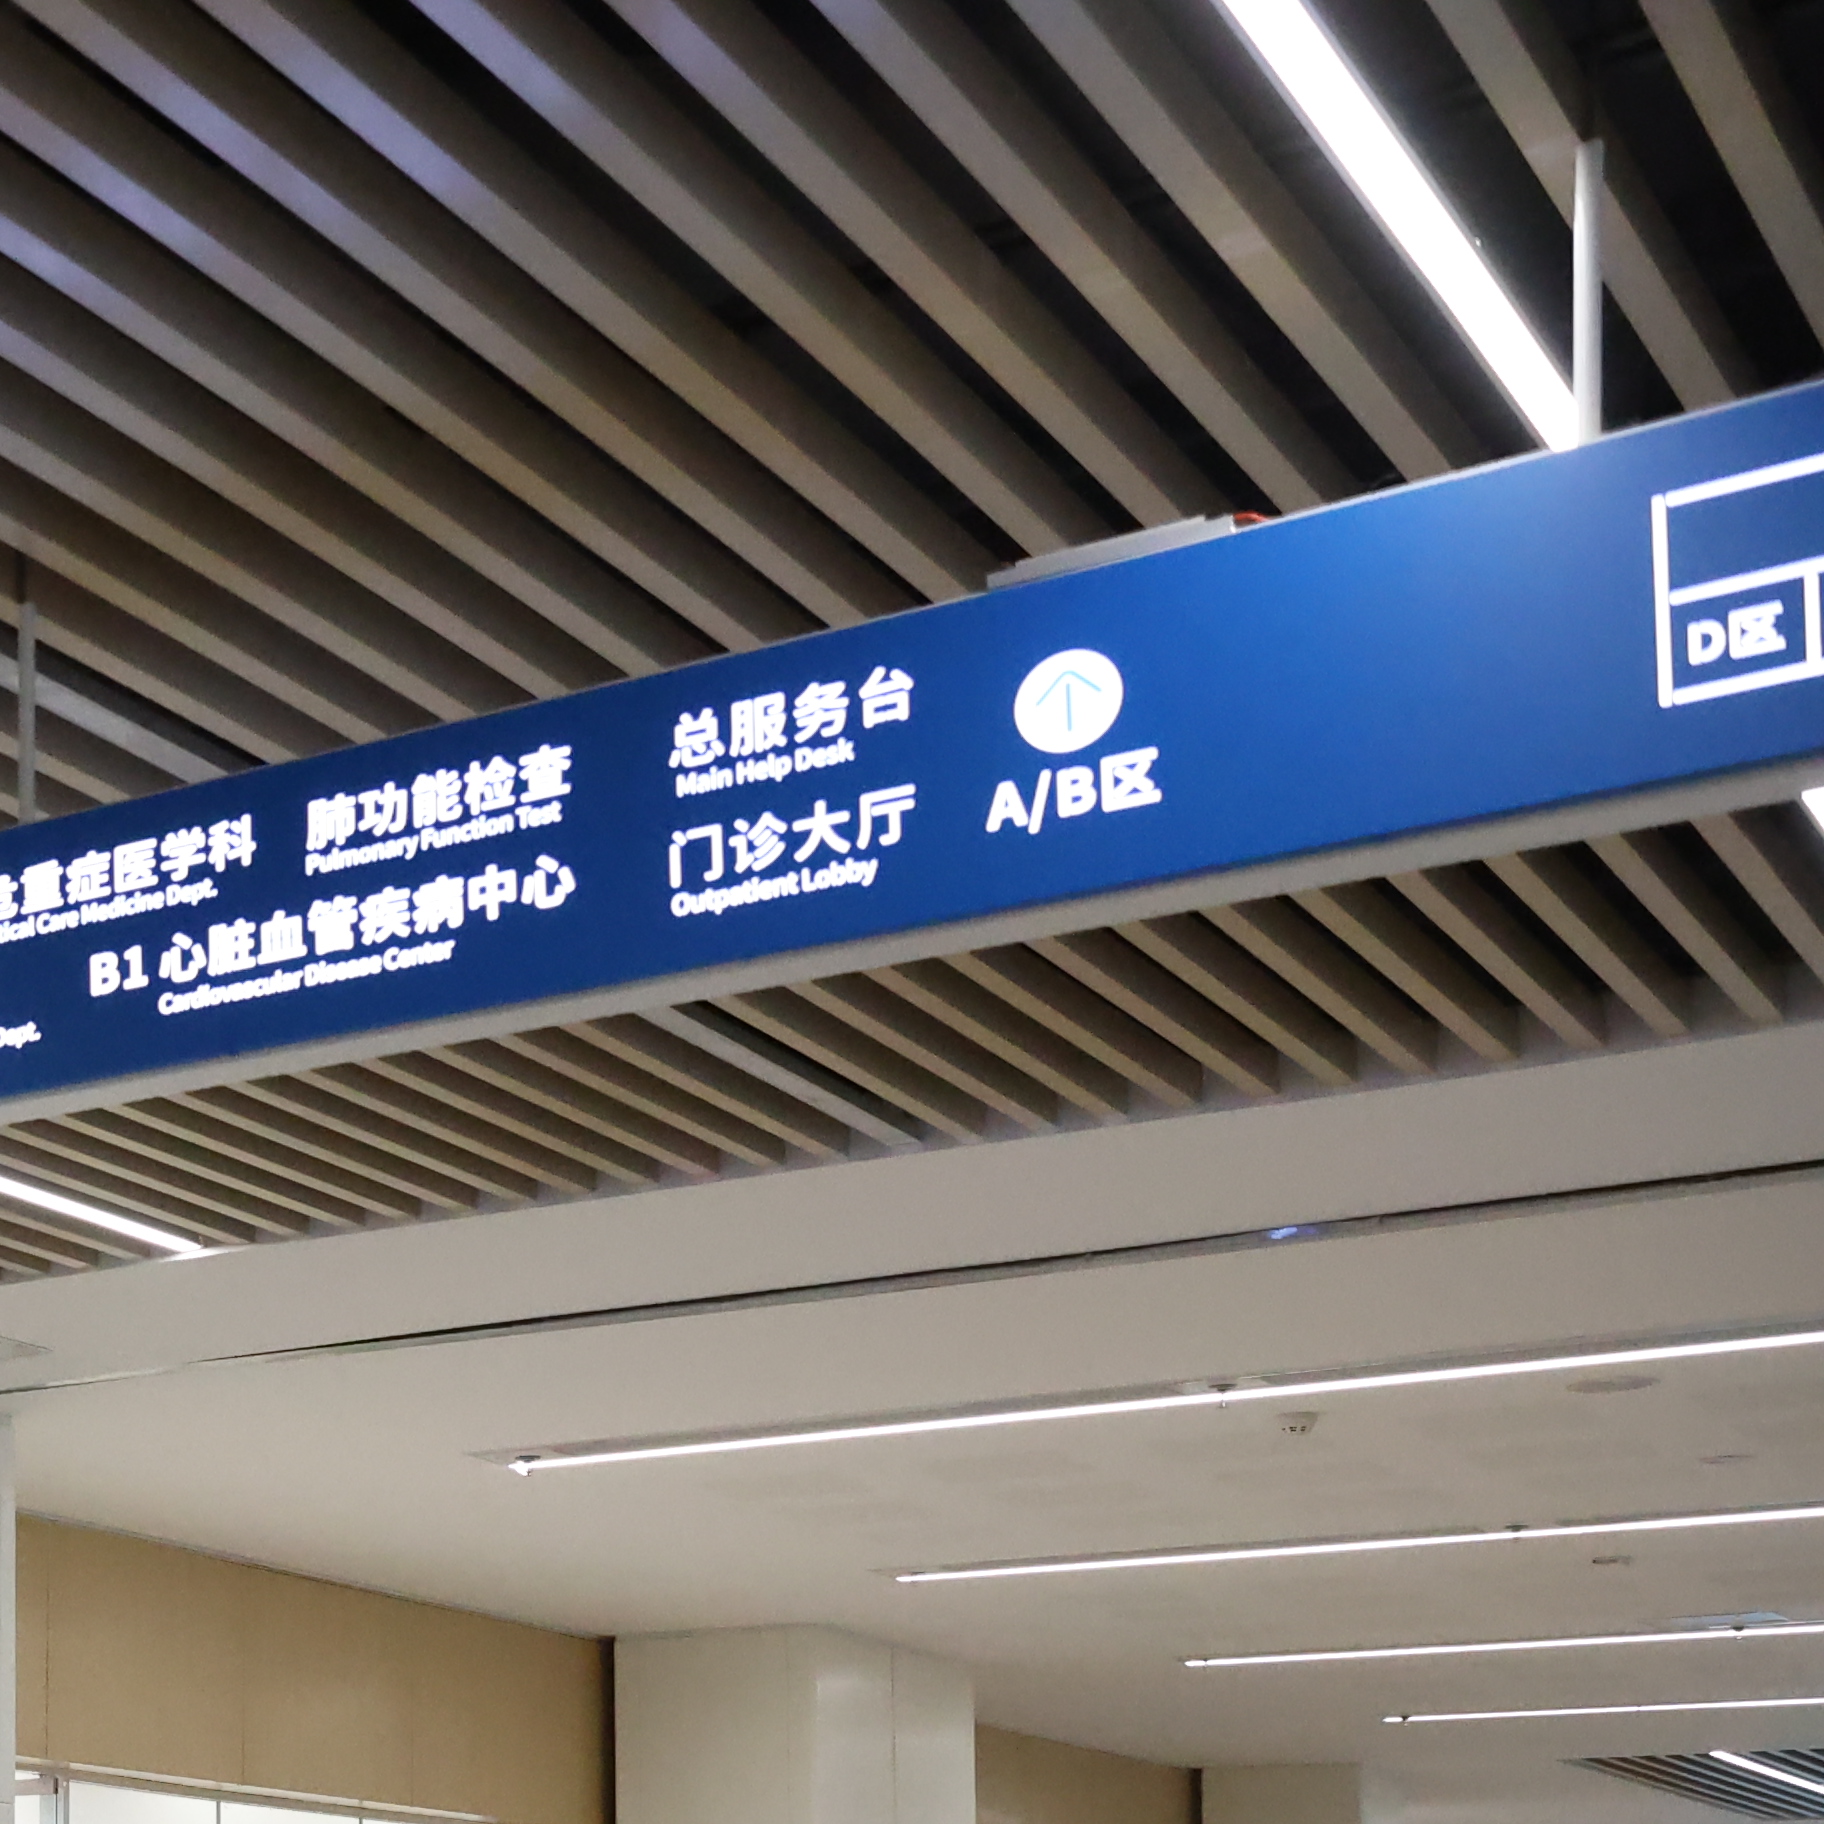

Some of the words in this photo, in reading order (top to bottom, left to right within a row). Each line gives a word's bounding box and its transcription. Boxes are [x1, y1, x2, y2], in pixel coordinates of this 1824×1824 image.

[1687, 599, 1787, 666] D区
[669, 666, 915, 769] 总服务台
[304, 743, 573, 852] 肺功能检查
[675, 762, 733, 798] Main
[735, 750, 793, 785] Help
[795, 738, 855, 773] Desk
[985, 745, 1162, 836] A/B区
[304, 832, 420, 876] Pulmonary
[420, 812, 514, 851] Function
[514, 800, 562, 830] Test
[668, 784, 916, 889] 门诊大厅
[35, 908, 79, 937] Care
[79, 887, 165, 925] Medicine
[166, 876, 218, 908] Dept.
[89, 945, 149, 997] B1
[158, 854, 578, 985] 心脏血管疾病中心
[670, 870, 802, 917] Outpatient
[802, 856, 879, 895] Lobby
[158, 967, 304, 1017] Cardiovascular
[303, 951, 382, 988] Disease
[382, 938, 457, 972] Center
